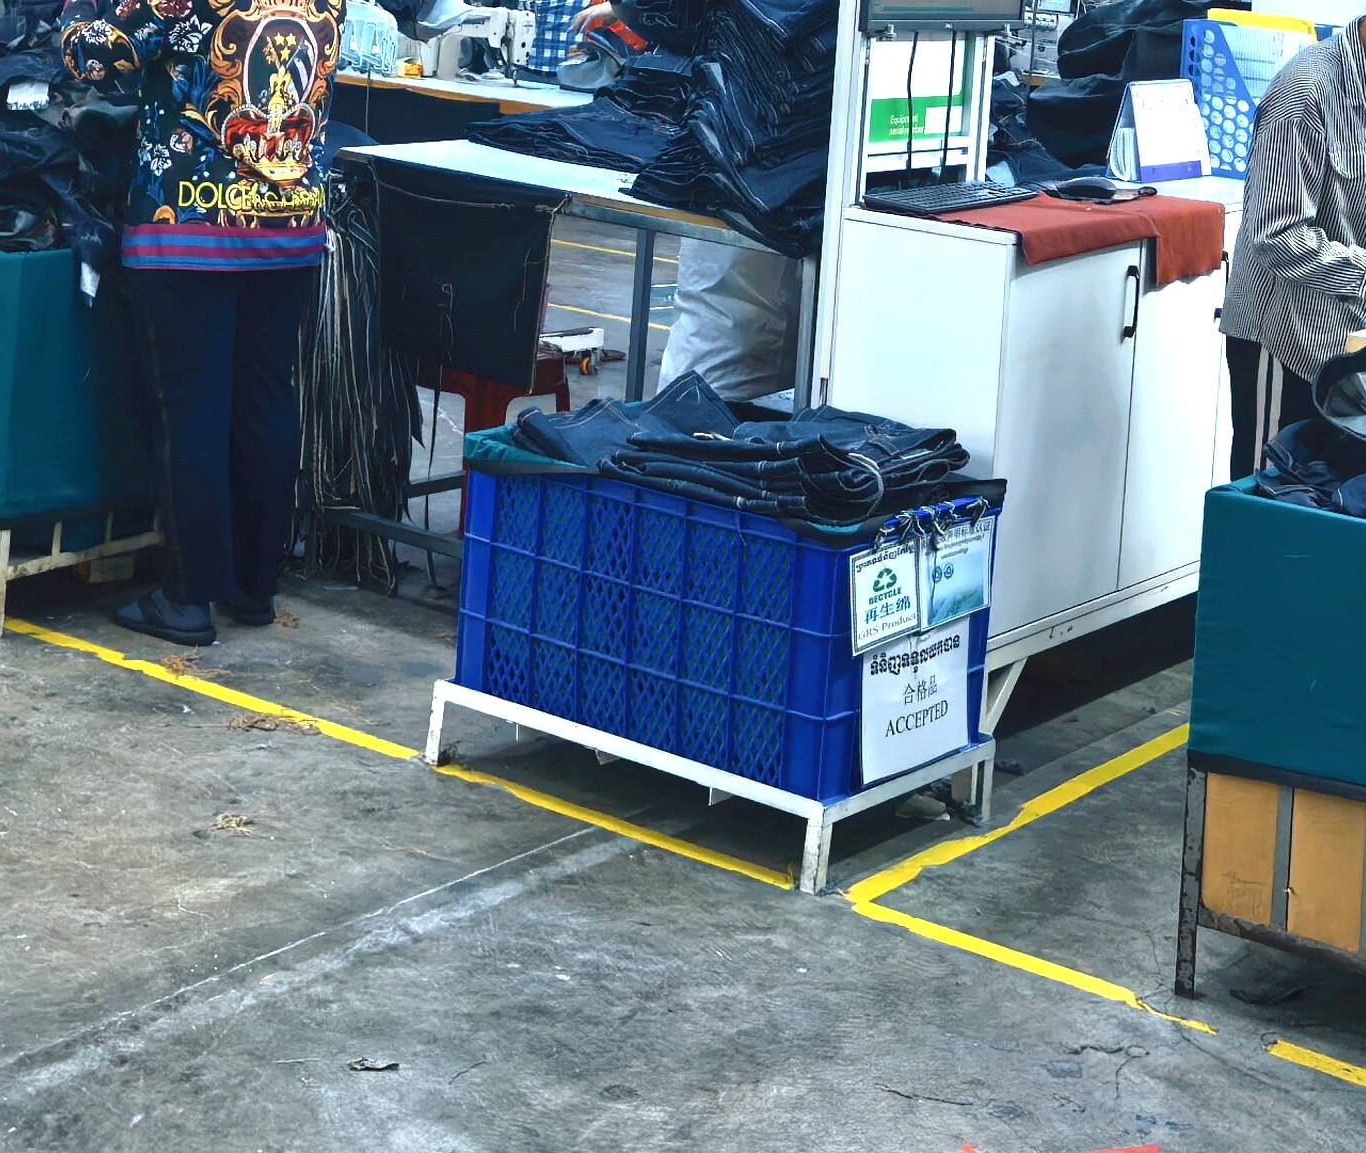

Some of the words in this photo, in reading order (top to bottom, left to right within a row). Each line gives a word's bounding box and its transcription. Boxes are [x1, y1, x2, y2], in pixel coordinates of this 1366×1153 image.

[868, 586, 902, 605] RECYCLE
[858, 625, 880, 641] GRS
[882, 613, 916, 631] Product
[904, 674, 938, 705] 合格品
[885, 699, 949, 737] ACCEPTED
